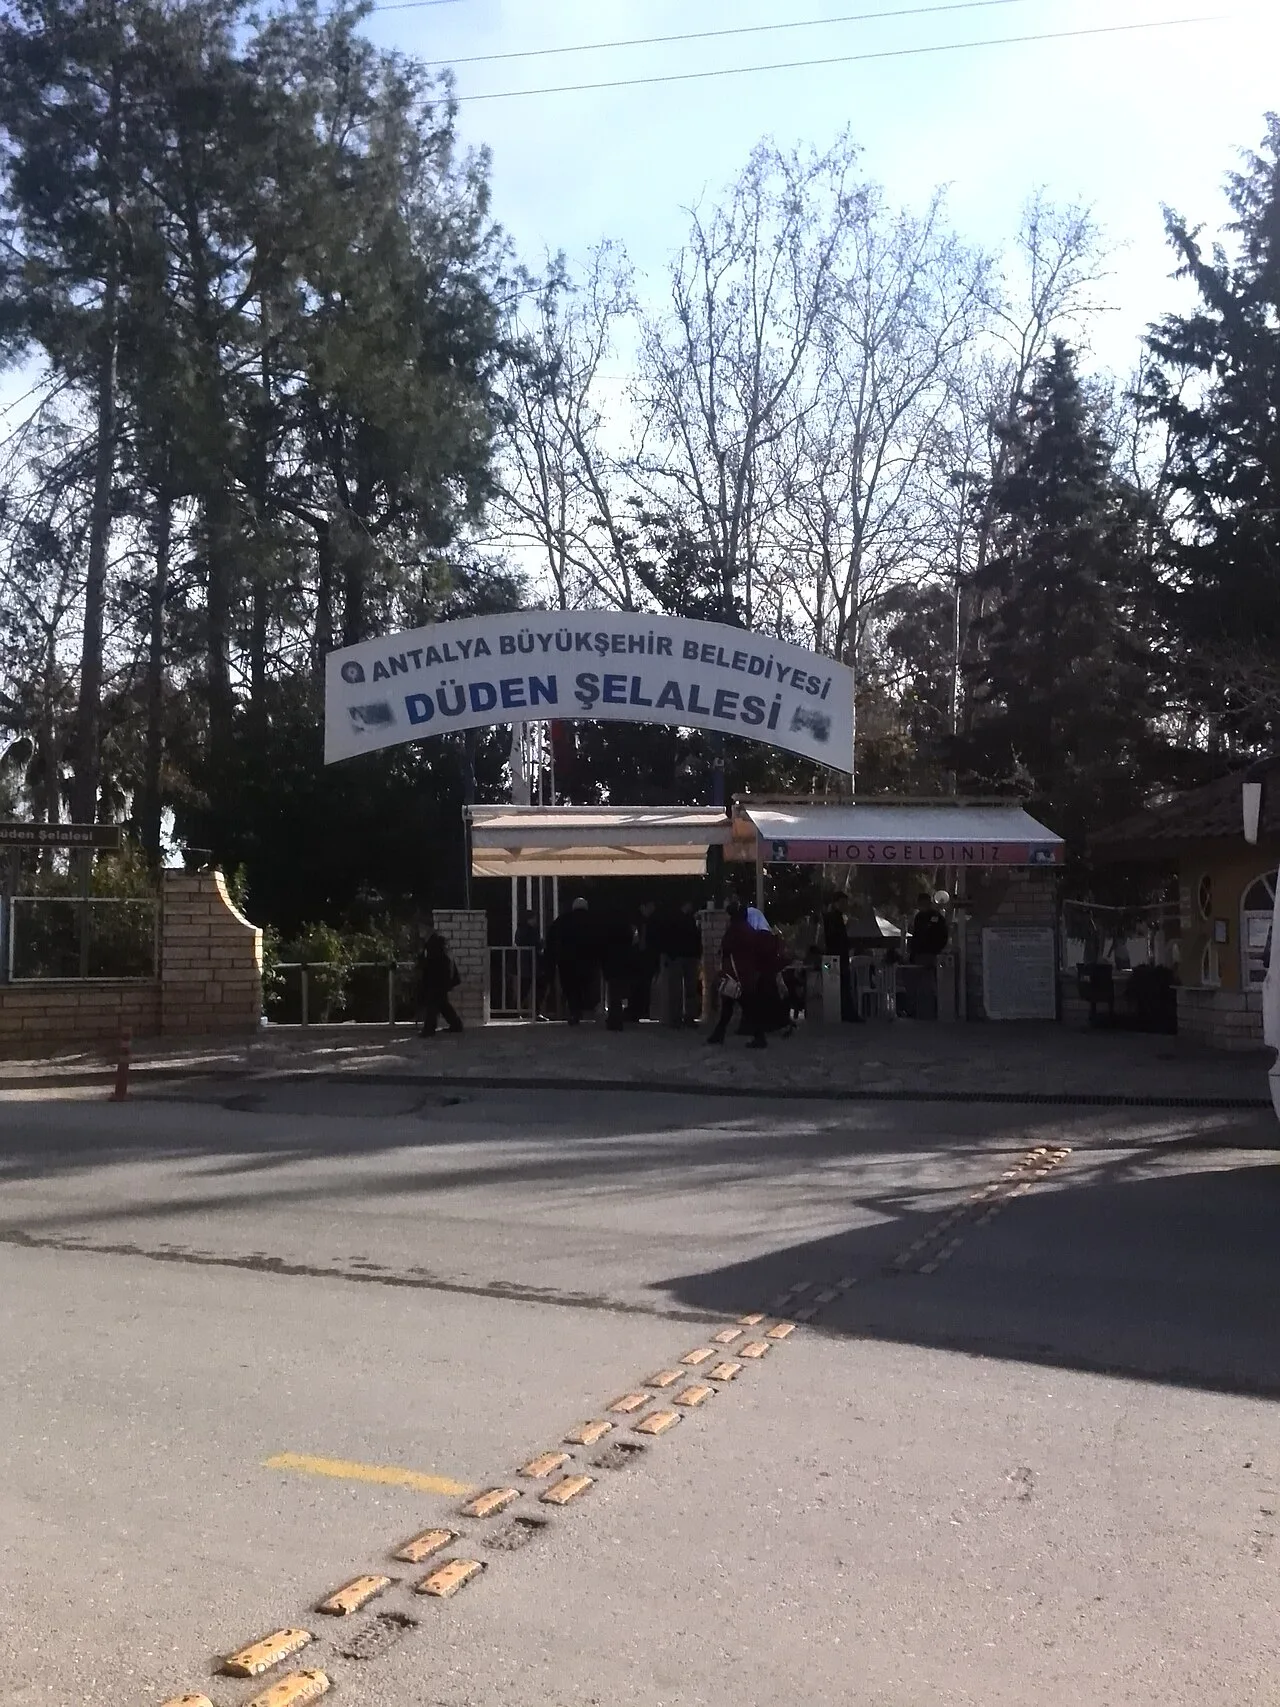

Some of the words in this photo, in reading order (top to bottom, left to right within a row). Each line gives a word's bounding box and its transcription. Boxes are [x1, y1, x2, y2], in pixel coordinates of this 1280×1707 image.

[373, 637, 492, 682] ANTALYA
[499, 628, 673, 657] BÜYÜKŞEHİR
[683, 639, 832, 700] BELEDİYESİ
[405, 679, 559, 725] DÜDEN
[574, 672, 782, 730] ŞELALESİ
[0, 829, 34, 840] üden
